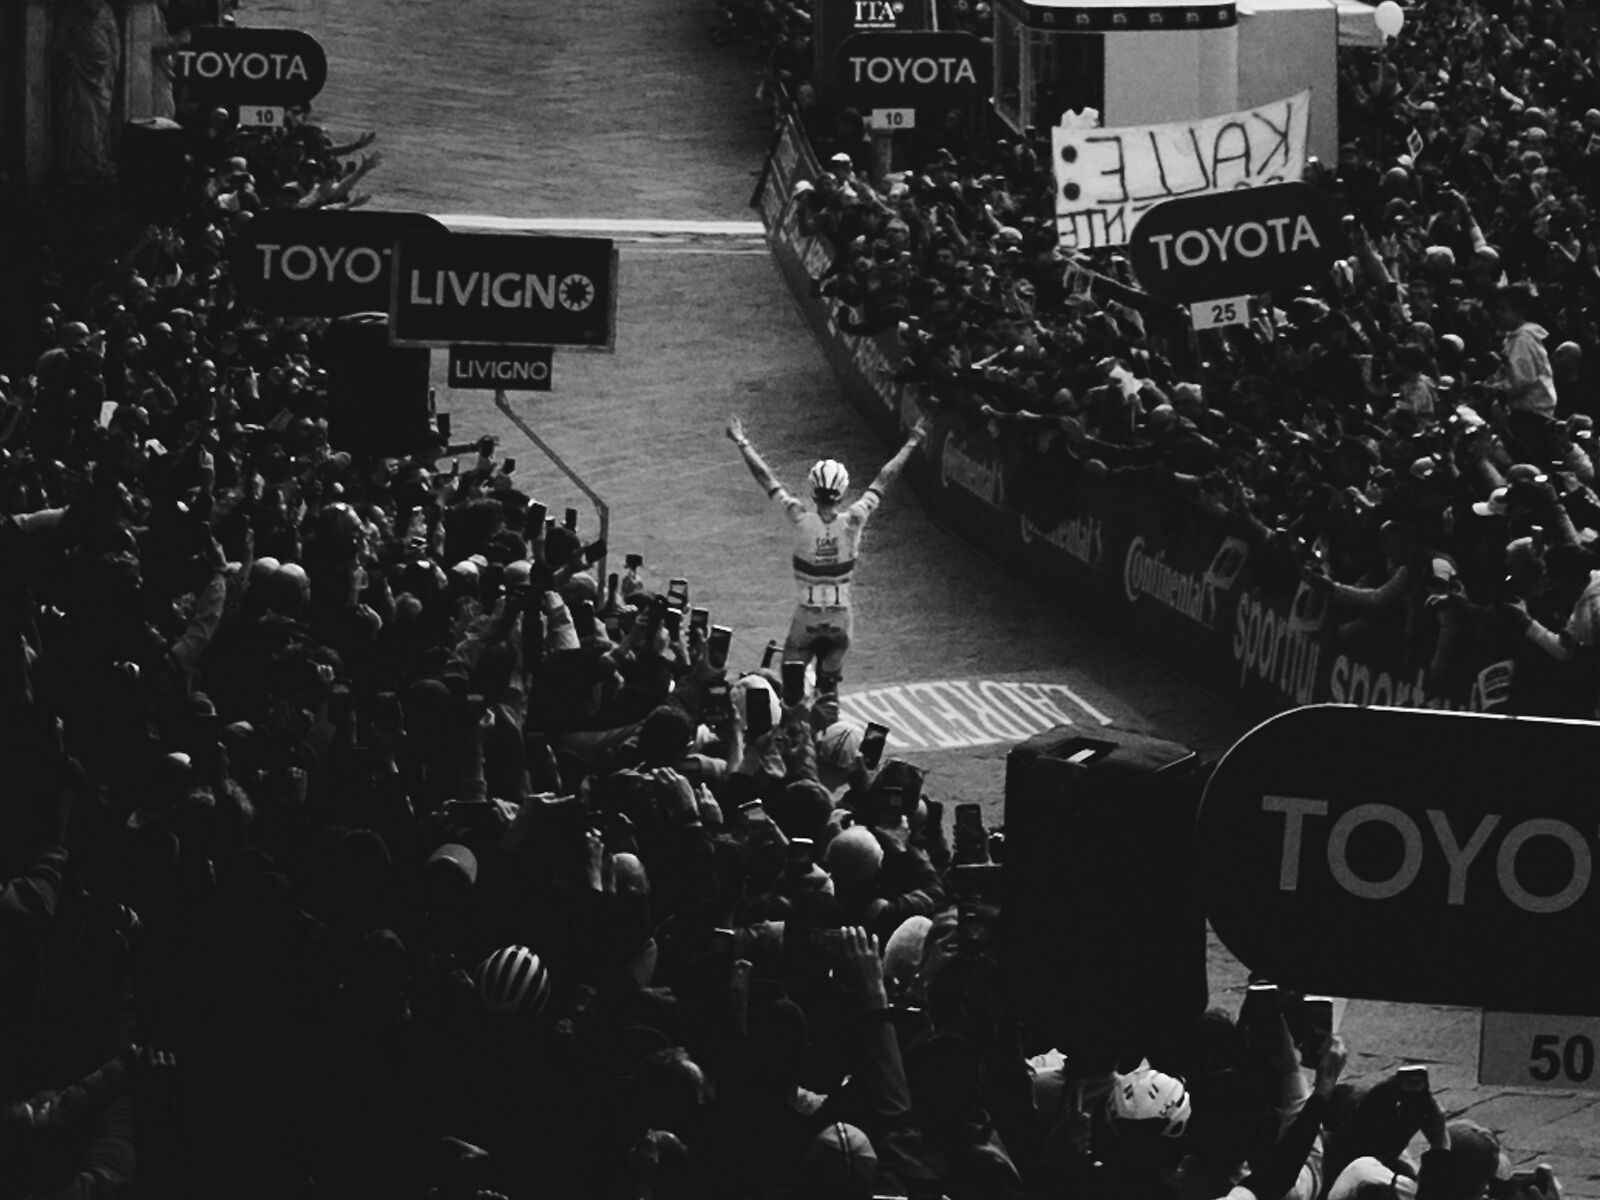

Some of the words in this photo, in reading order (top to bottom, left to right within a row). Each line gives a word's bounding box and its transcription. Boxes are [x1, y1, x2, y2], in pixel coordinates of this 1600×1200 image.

[177, 51, 308, 81] TOYOTA
[849, 57, 977, 84] TOYOTA
[255, 109, 273, 124] 10
[886, 110, 902, 125] 10
[1148, 214, 1321, 271] TOYOTA
[255, 243, 392, 284] TOYO
[410, 269, 595, 312] LIVIGNO
[1211, 303, 1237, 324] 25
[455, 360, 549, 380] LIVIGNO
[1261, 794, 1600, 913] TOYO
[1528, 1033, 1595, 1083] 50
